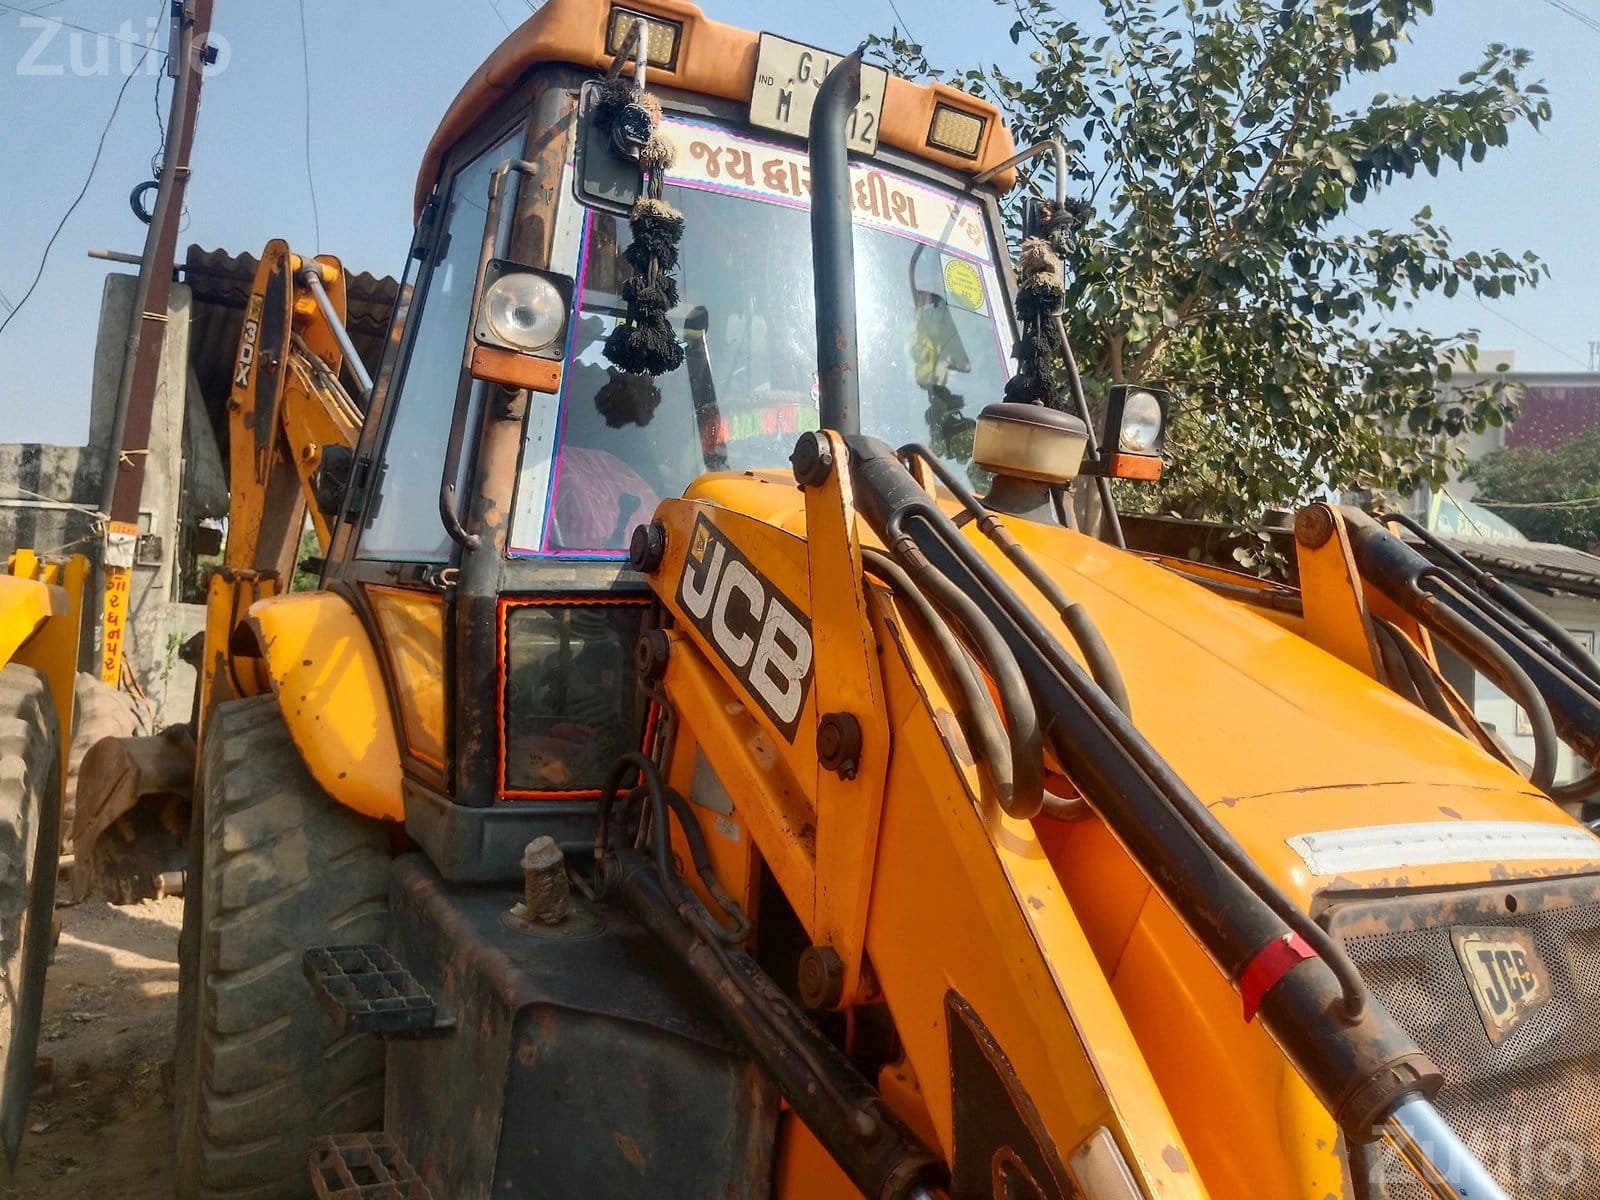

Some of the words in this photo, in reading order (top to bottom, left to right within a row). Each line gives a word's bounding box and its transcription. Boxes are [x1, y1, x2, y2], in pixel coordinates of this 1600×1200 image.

[759, 74, 774, 86] IND
[689, 141, 756, 187] જય
[682, 541, 813, 724] JCB
[1477, 950, 1535, 1015] JCB
